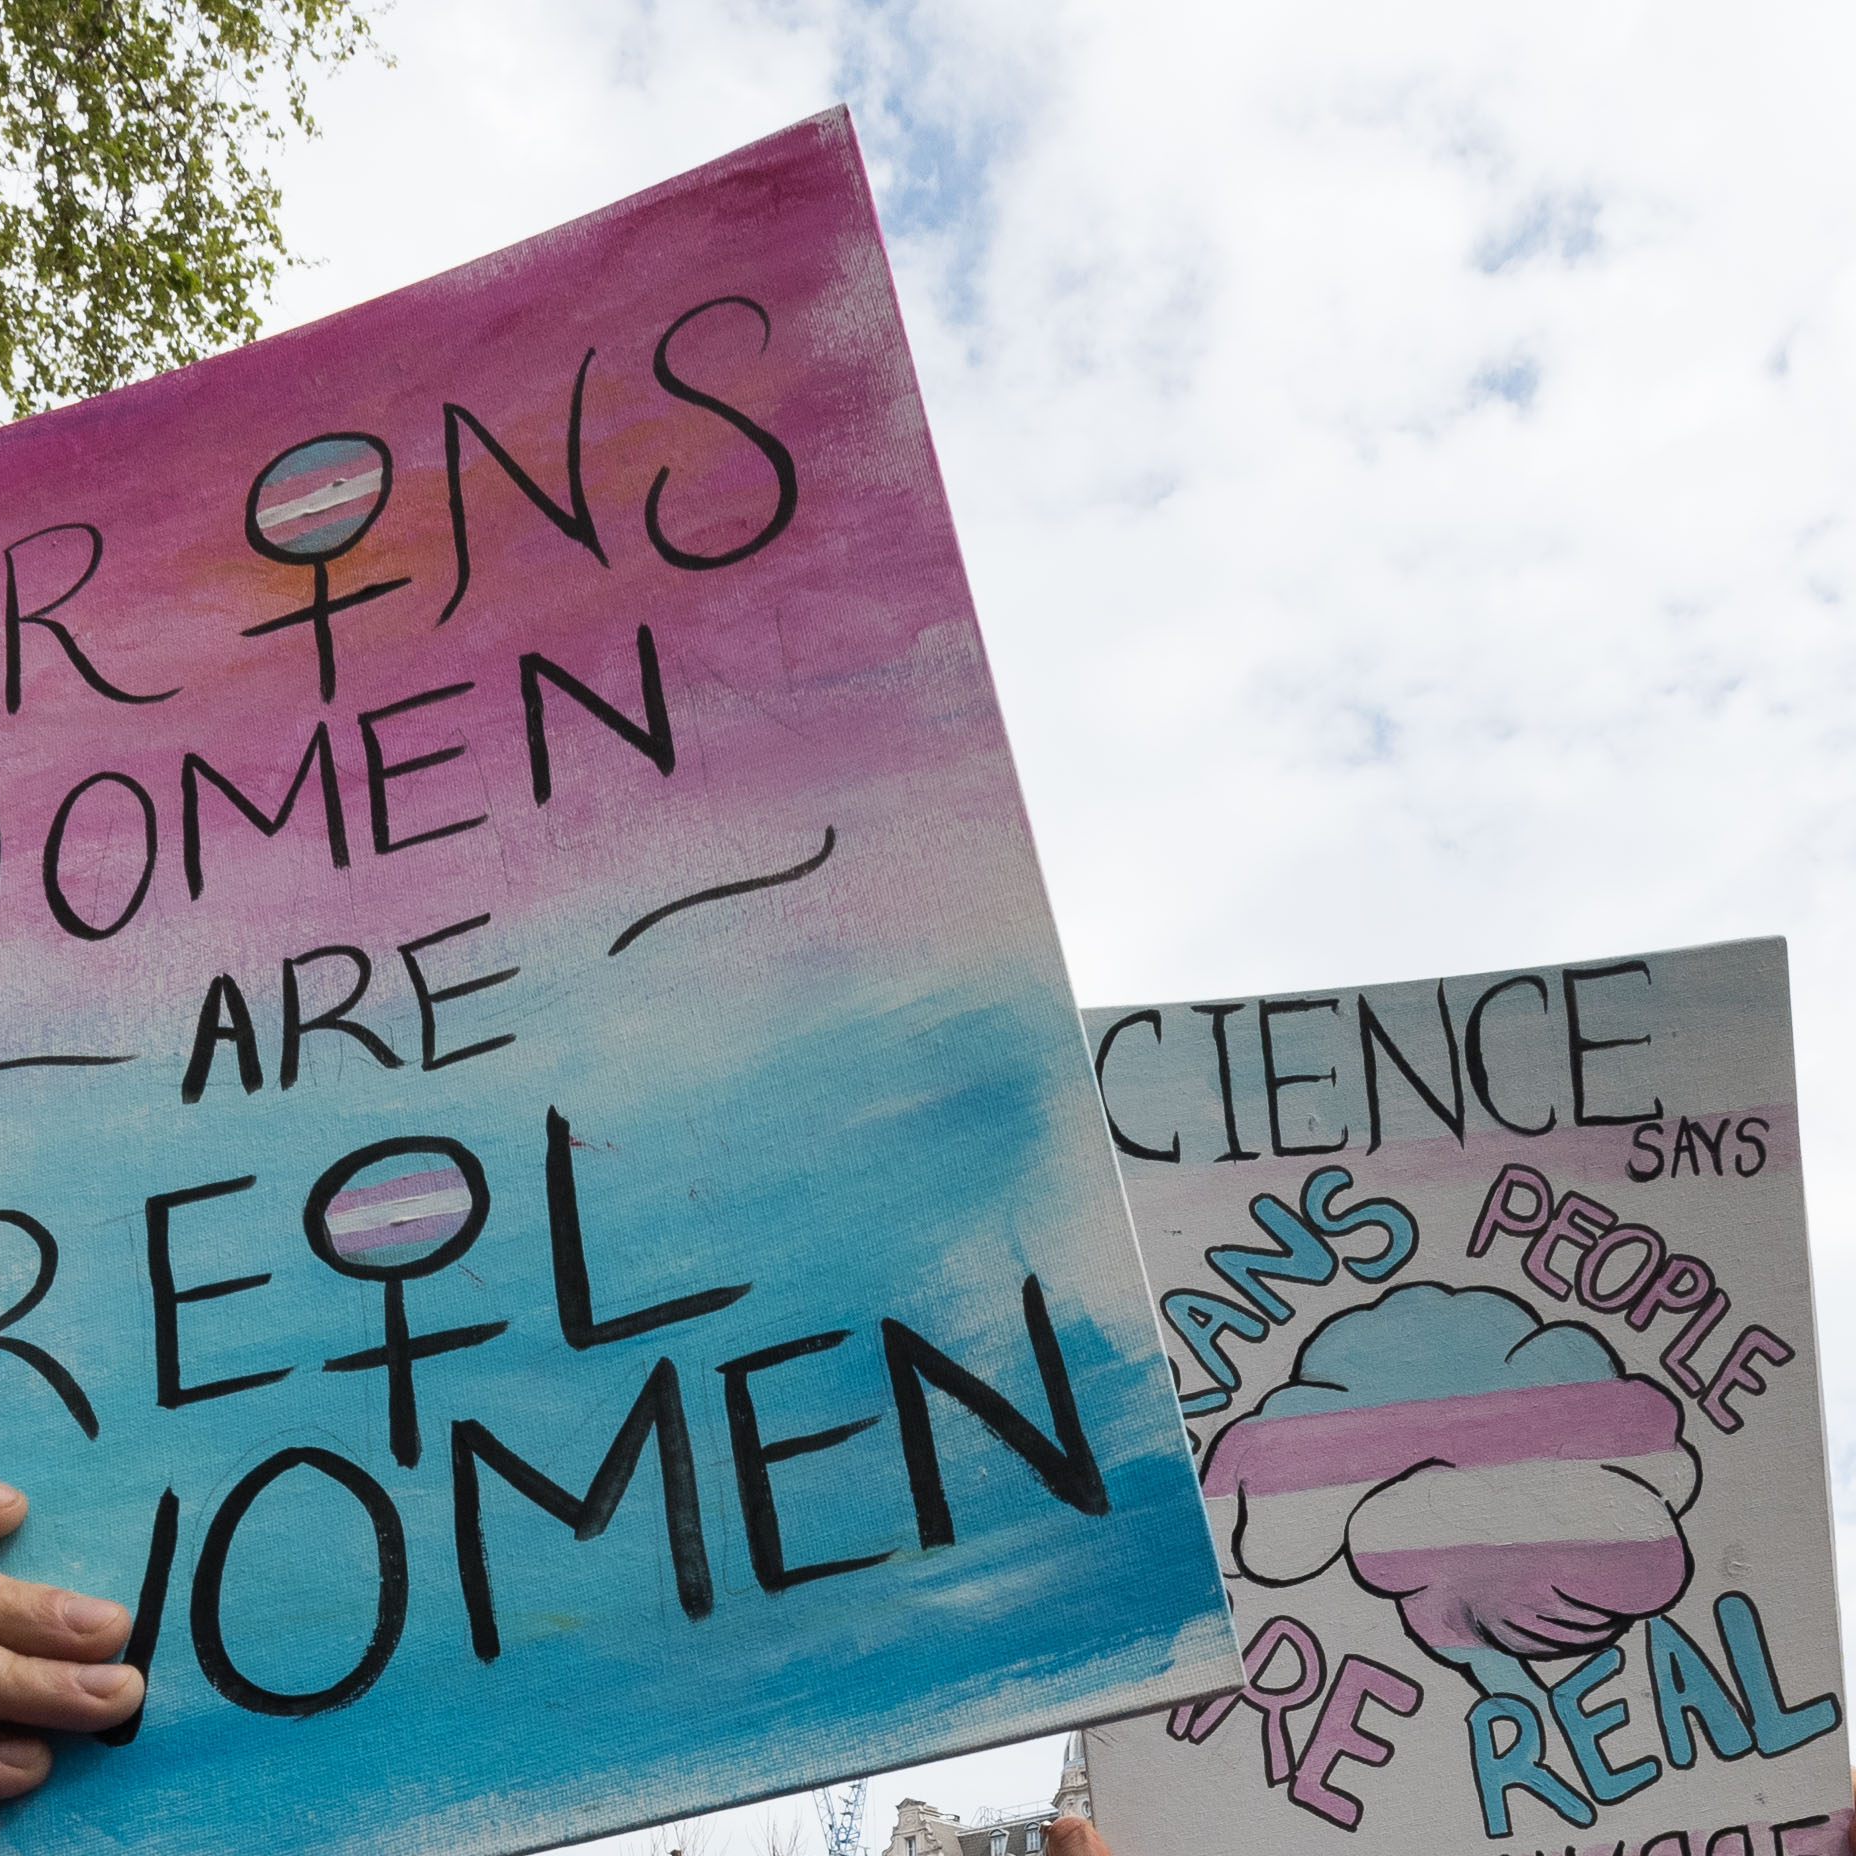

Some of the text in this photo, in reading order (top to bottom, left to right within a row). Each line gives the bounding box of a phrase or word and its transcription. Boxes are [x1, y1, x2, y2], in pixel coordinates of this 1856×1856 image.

[182, 912, 522, 1103] ARE
[1095, 961, 1664, 1165] CIENCE
[1625, 1116, 1769, 1183] SAYS
[1161, 1163, 1797, 1455] ANS PEOPLE
[1166, 1590, 1843, 1839] RE REAL
